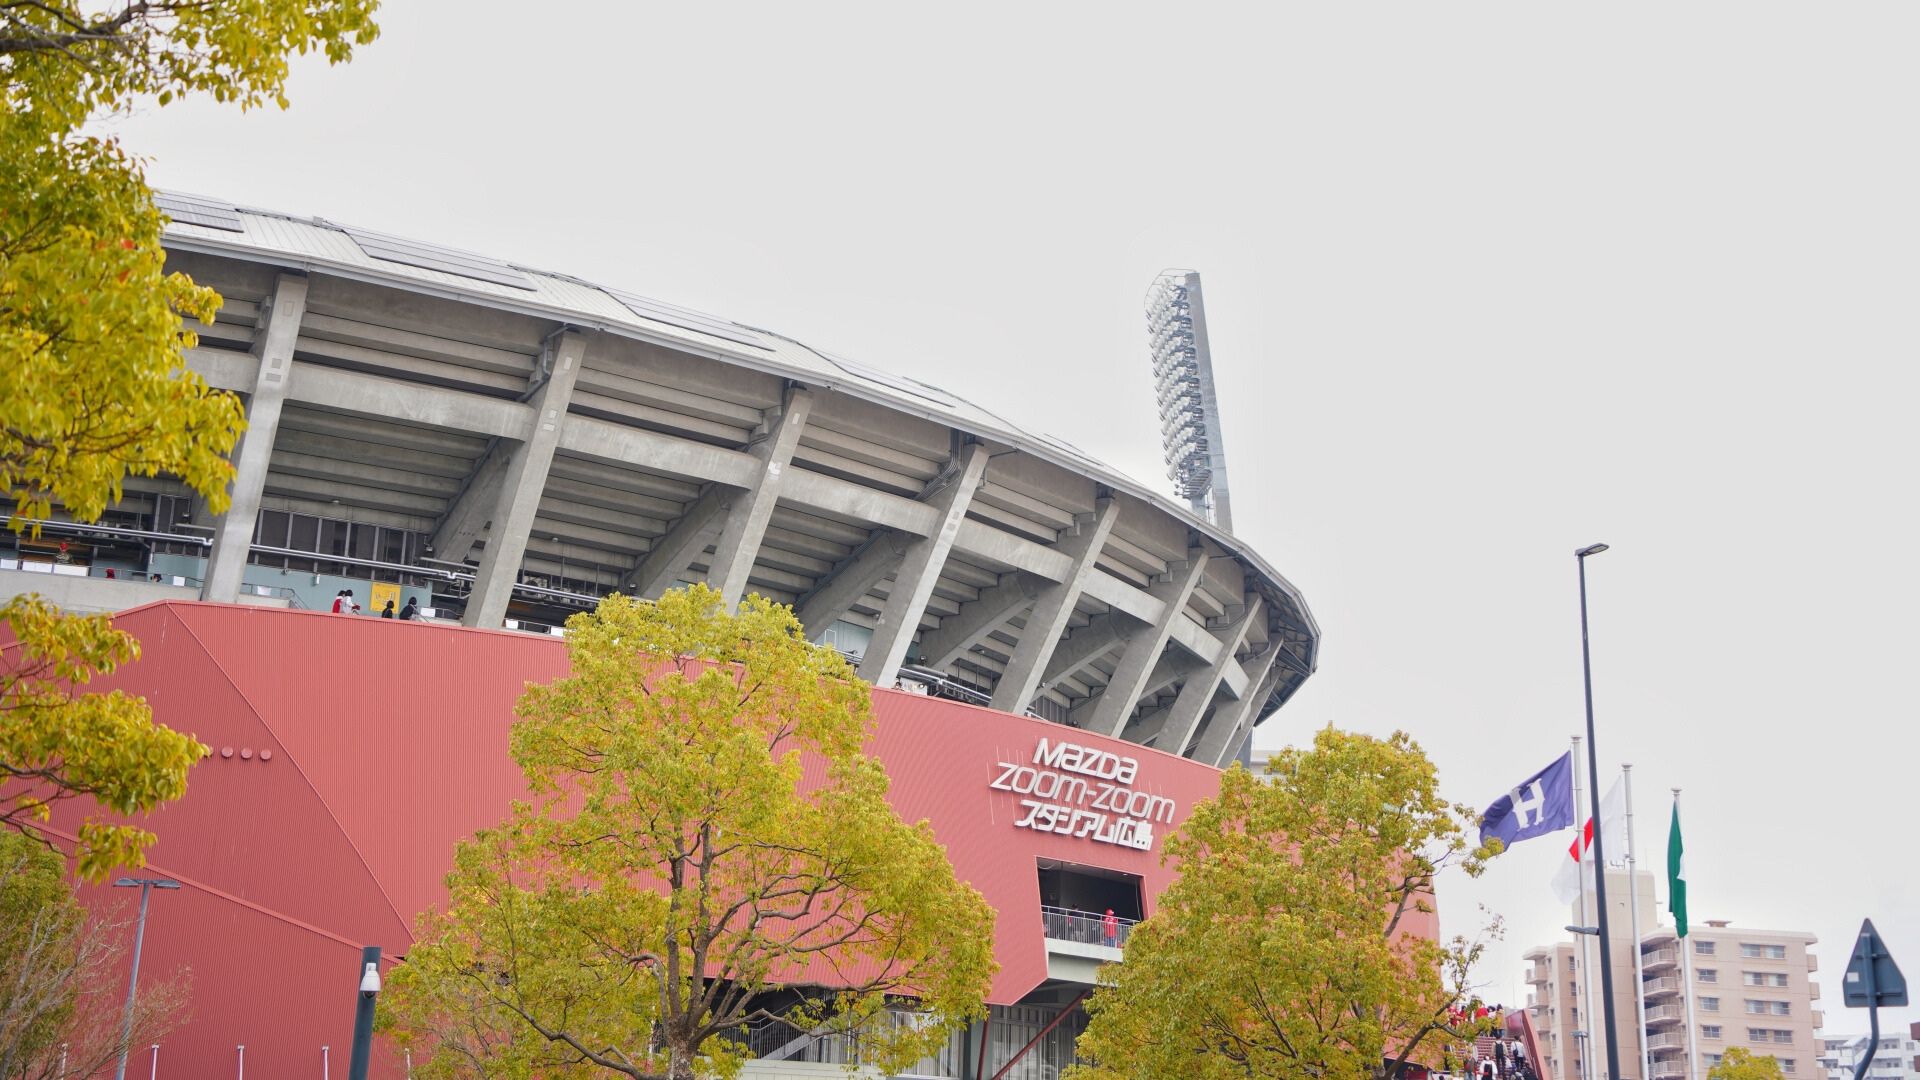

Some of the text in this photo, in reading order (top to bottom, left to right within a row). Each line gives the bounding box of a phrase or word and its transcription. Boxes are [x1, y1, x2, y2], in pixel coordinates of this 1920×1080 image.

[1014, 800, 1153, 850] スタジアム広島
[1511, 779, 1545, 830] H
